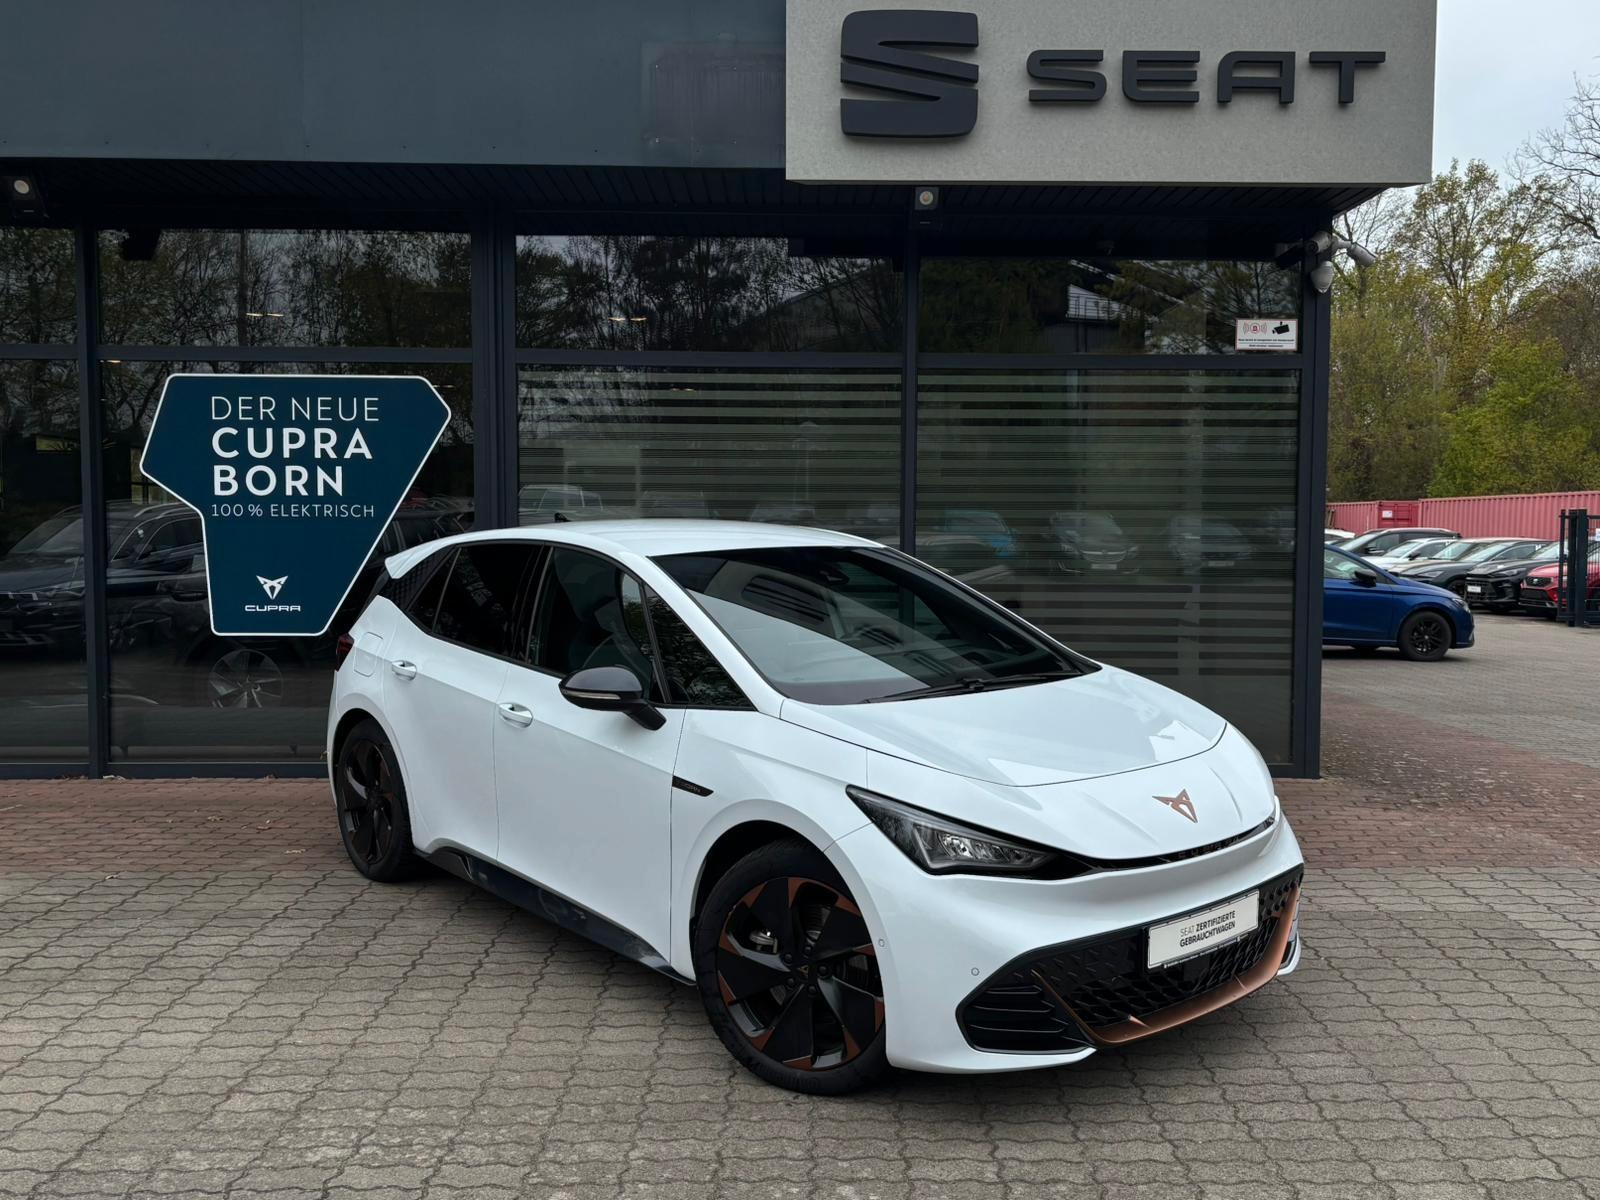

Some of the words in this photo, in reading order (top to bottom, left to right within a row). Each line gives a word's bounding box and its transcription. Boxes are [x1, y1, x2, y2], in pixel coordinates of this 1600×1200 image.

[1026, 49, 1386, 104] SEAT
[211, 396, 276, 421] DER
[291, 397, 380, 422] NEUE
[211, 427, 373, 460] CUPRA
[213, 465, 343, 496] BORN
[270, 504, 375, 518] ELEKTRISCH
[244, 604, 301, 612] CUPRA
[1180, 925, 1195, 937] SEAT
[1196, 911, 1236, 932] ZERTIFIZIERTE
[1180, 921, 1236, 947] GEBRAUCHTWAGEN
